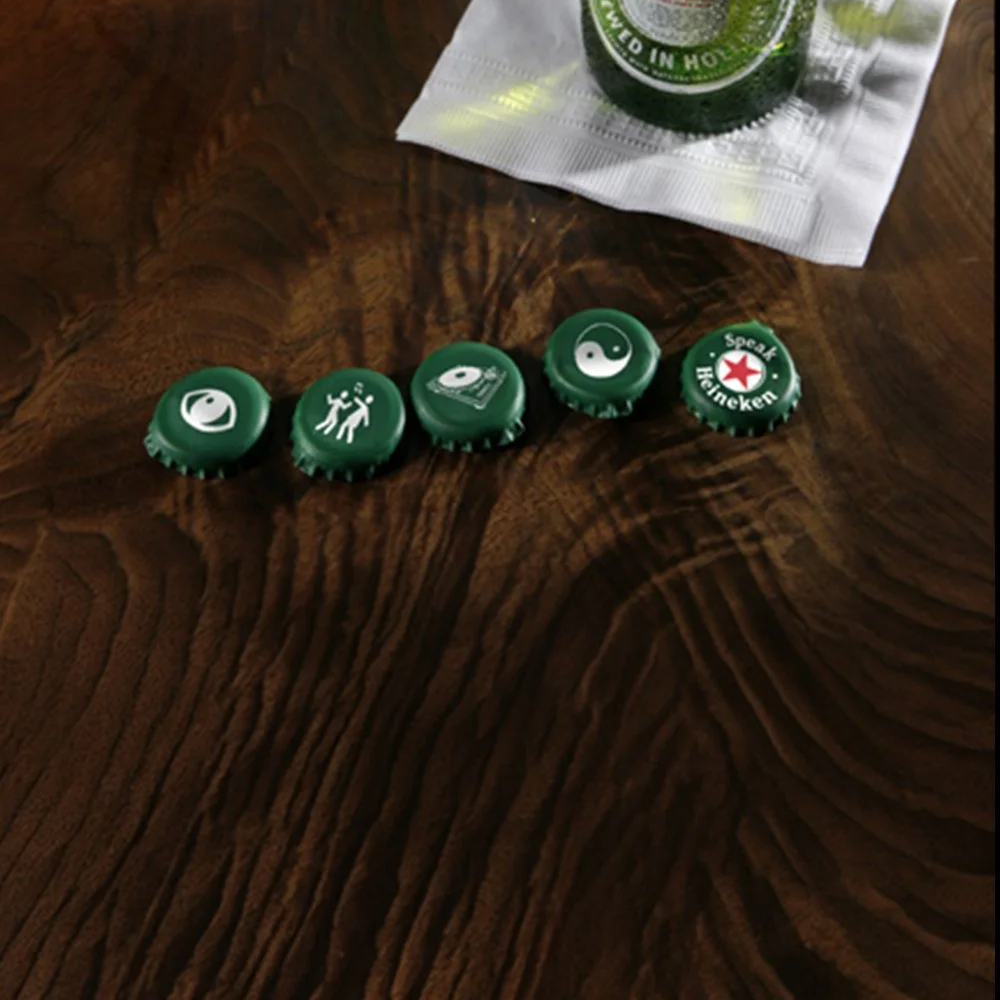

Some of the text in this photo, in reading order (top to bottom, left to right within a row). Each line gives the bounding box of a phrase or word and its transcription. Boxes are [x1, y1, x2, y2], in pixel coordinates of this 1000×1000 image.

[650, 48, 675, 70] IN
[724, 332, 777, 361] Speak
[695, 367, 778, 411] Heineken
